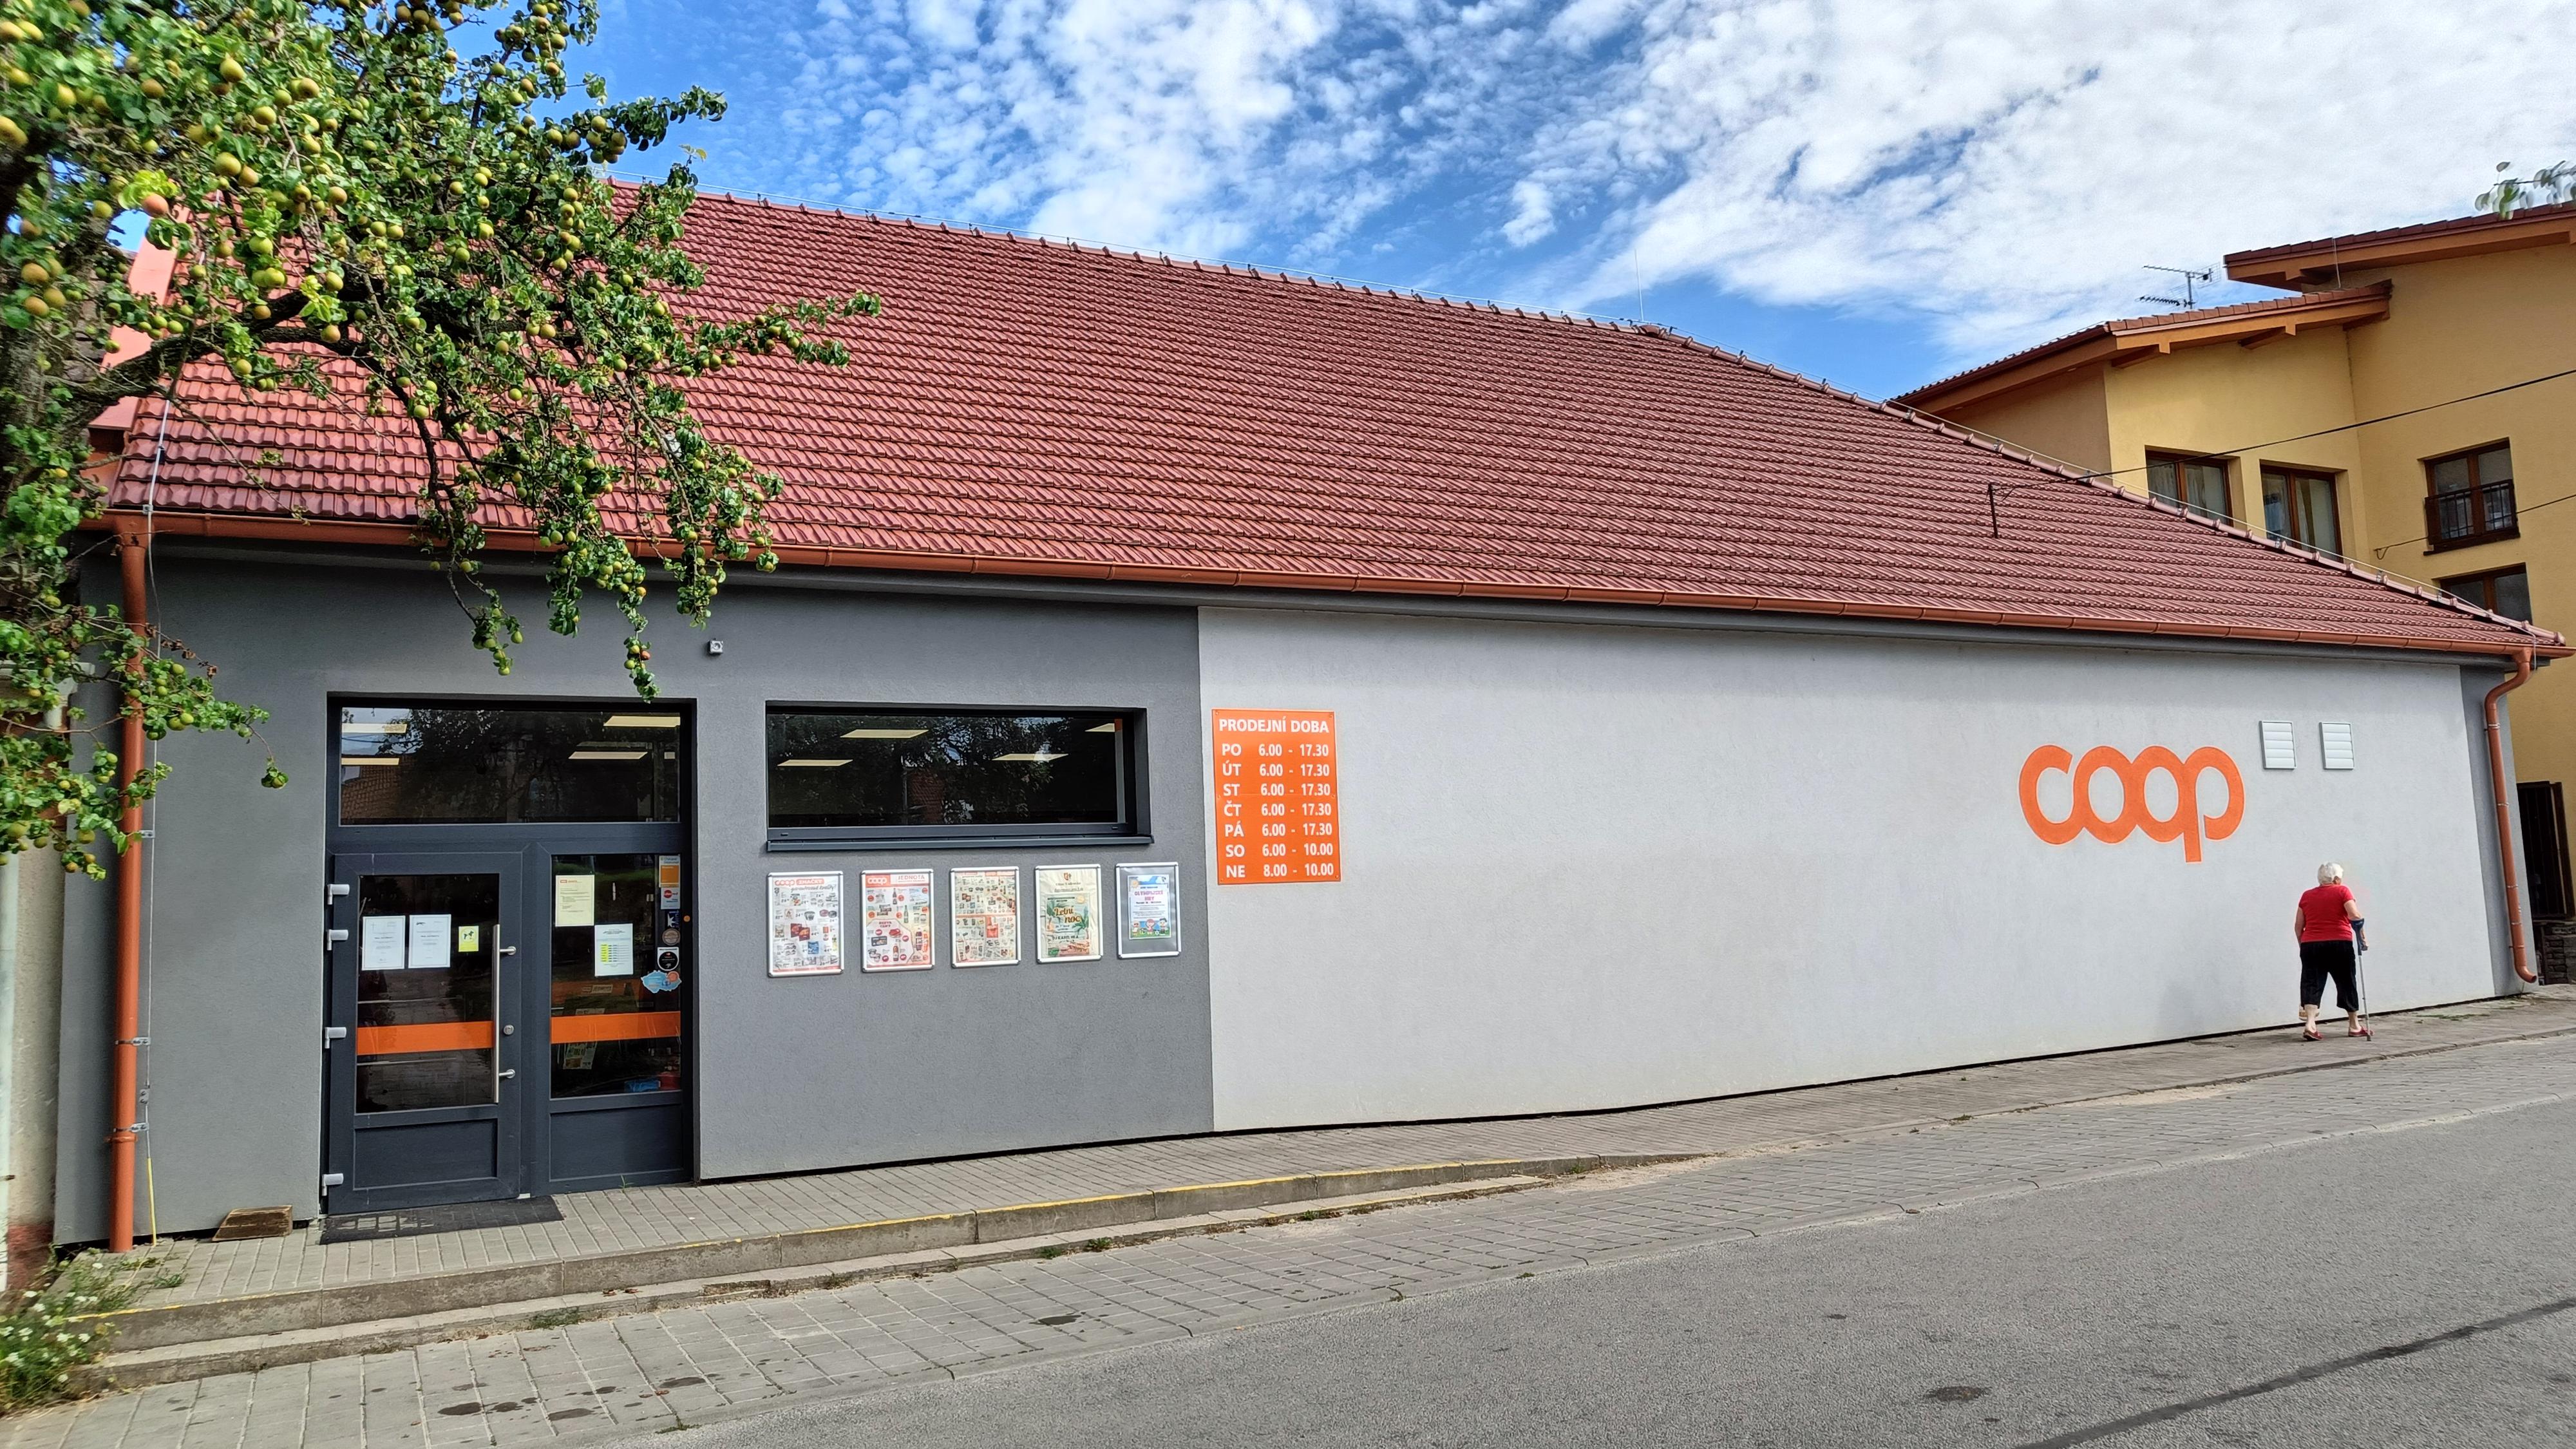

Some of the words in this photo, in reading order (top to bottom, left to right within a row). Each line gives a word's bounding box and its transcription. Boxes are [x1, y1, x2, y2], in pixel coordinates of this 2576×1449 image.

[1219, 716, 1286, 732] PRODEJNÍ
[1291, 720, 1329, 733] DOBA
[1222, 744, 1241, 756] PO
[1258, 744, 1282, 757] 6.00
[1300, 744, 1329, 756] 17.30
[1222, 761, 1241, 776] ÚT
[1260, 764, 1283, 776] 6.00
[1301, 764, 1329, 776] 17.30
[1224, 784, 1240, 796] ST
[1260, 784, 1284, 796] 6.00
[1302, 784, 1330, 796] 17.30
[1224, 800, 1242, 817] ČT
[1261, 804, 1285, 816] 6.00
[1302, 804, 1331, 815] 17.30
[2018, 744, 2245, 864] coop
[1225, 821, 1244, 837] PÁ
[1262, 824, 1285, 836] 6.00
[1303, 824, 1332, 835] 17.30
[1226, 845, 1245, 857] SO
[1262, 844, 1285, 857] 6.00
[1304, 843, 1332, 855] 10.00
[1227, 865, 1245, 878] NE
[1264, 864, 1287, 876] 8.00
[1305, 864, 1333, 876] 10.00
[1054, 905, 1074, 916] Letní
